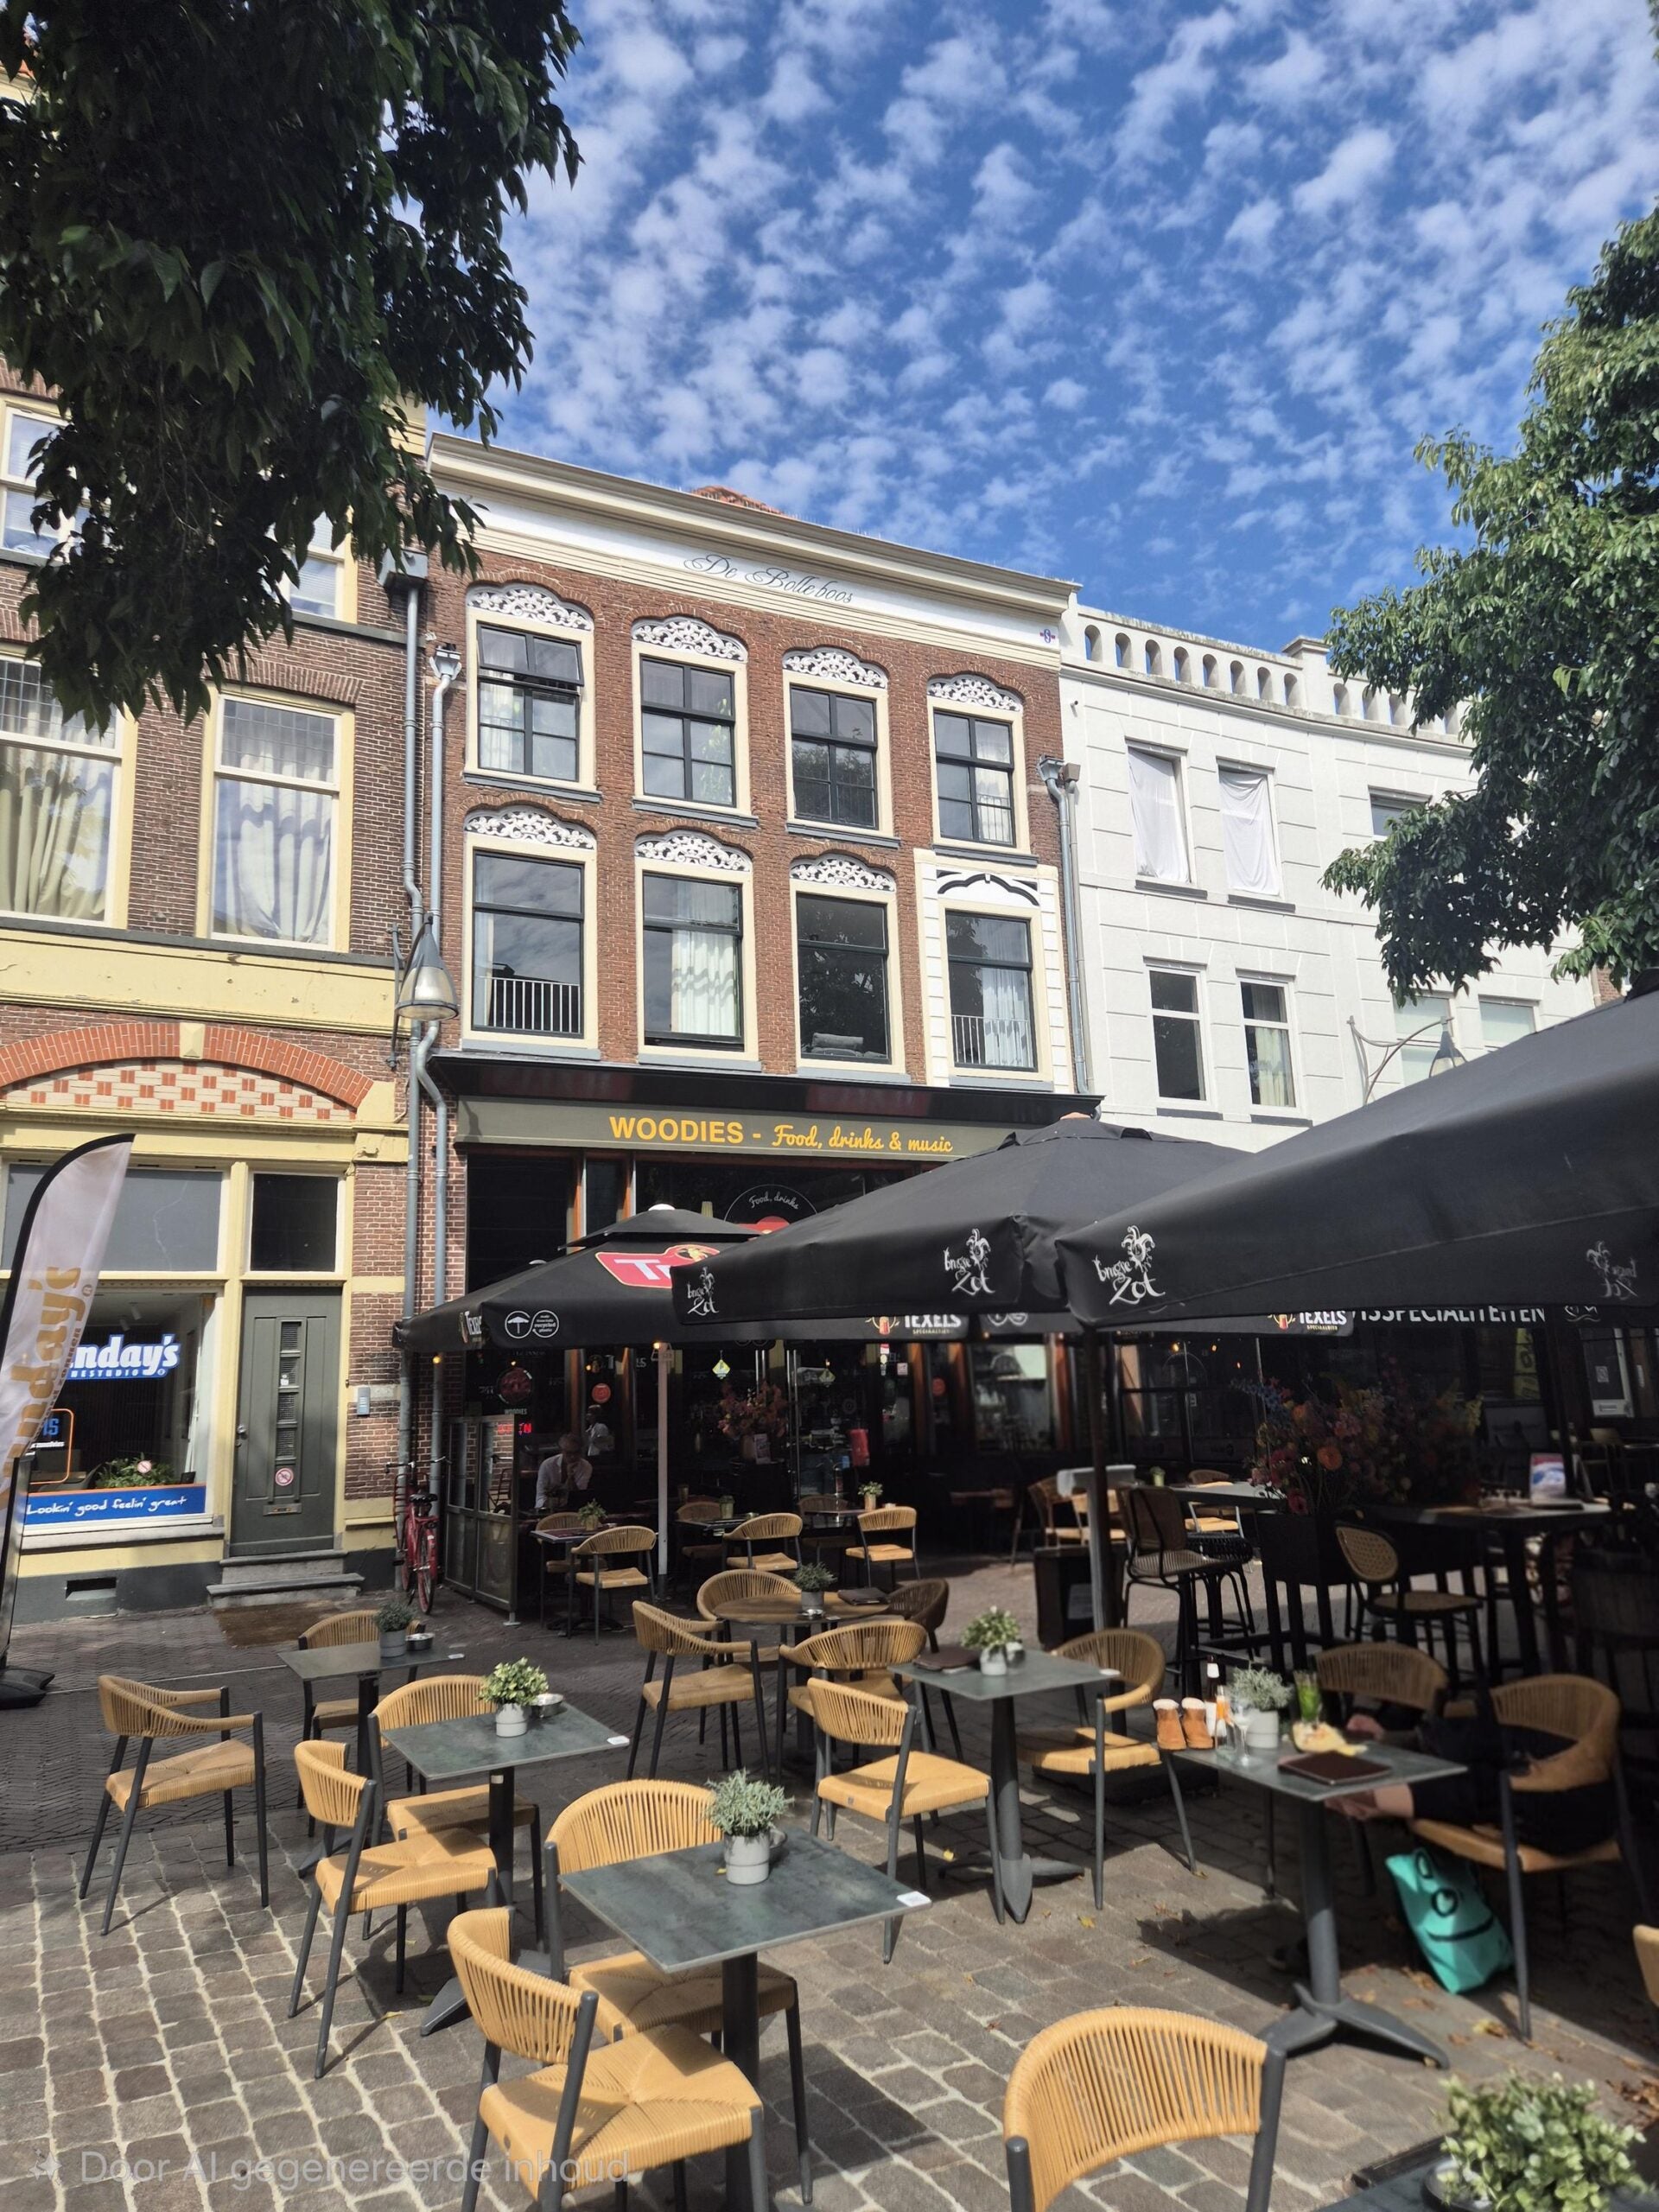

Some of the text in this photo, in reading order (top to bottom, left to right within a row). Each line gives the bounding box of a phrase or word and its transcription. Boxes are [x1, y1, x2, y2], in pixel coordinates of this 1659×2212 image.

[683, 554, 737, 578] De
[609, 1116, 744, 1144] WOODIES
[772, 1124, 823, 1148] Food,
[829, 1126, 884, 1149] drinks
[889, 1132, 902, 1151] &
[908, 1136, 953, 1153] music
[774, 1192, 799, 1210] drinks
[1109, 1271, 1166, 1306] Zot
[74, 1499, 108, 1516] good
[112, 1497, 147, 1510] feelin'
[148, 1496, 187, 1511] great
